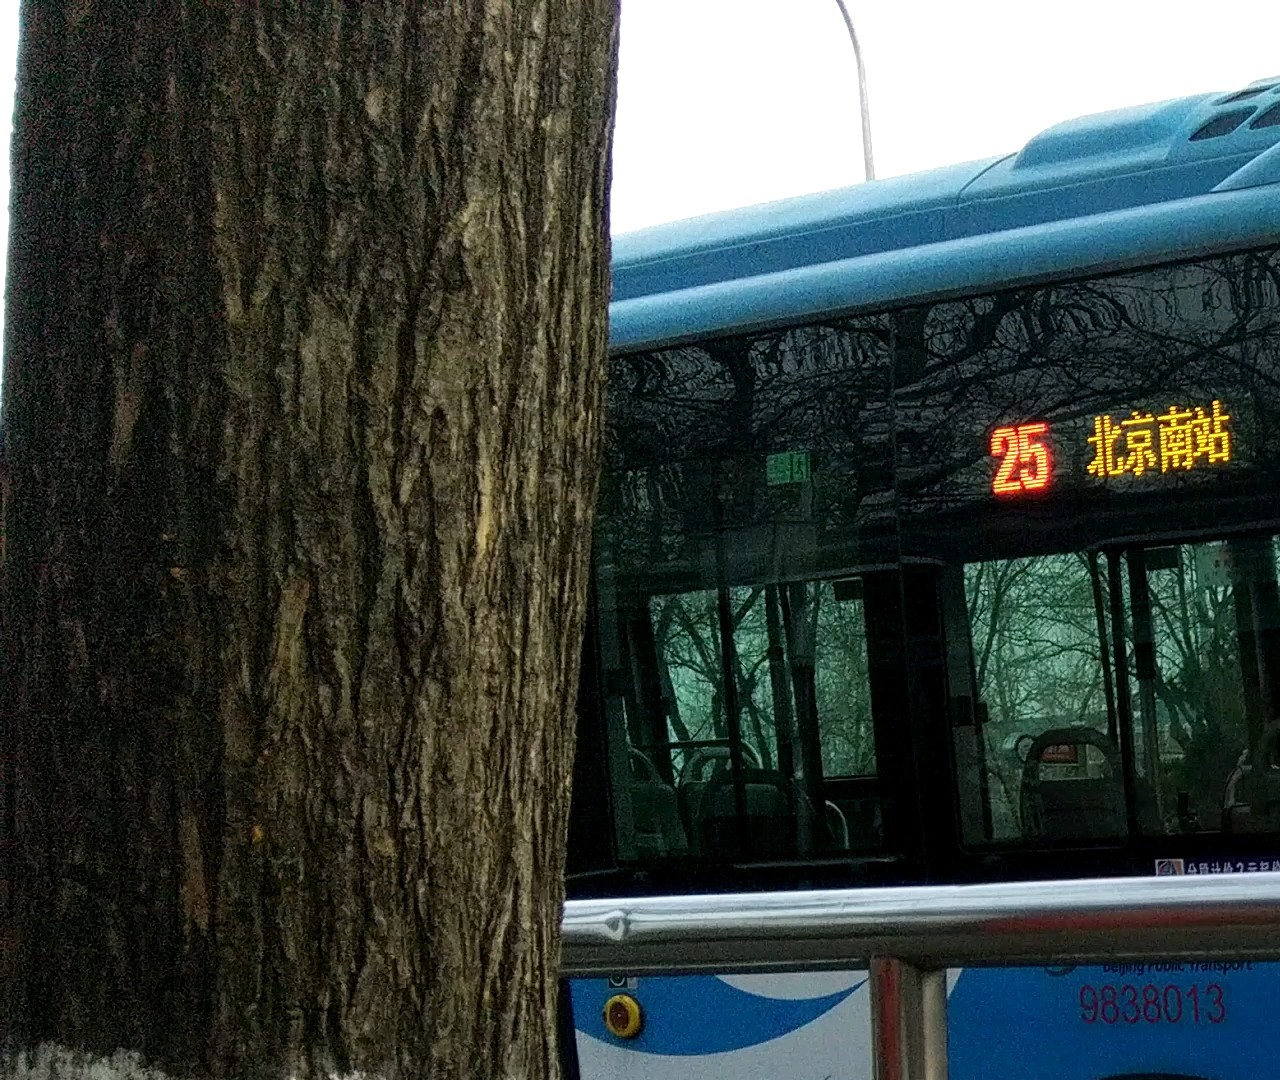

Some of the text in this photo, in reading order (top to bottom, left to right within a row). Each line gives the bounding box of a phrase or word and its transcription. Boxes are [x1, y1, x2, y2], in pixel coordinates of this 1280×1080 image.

[989, 400, 1231, 494] 25 北京南站
[1079, 982, 1226, 1025] 9838013
